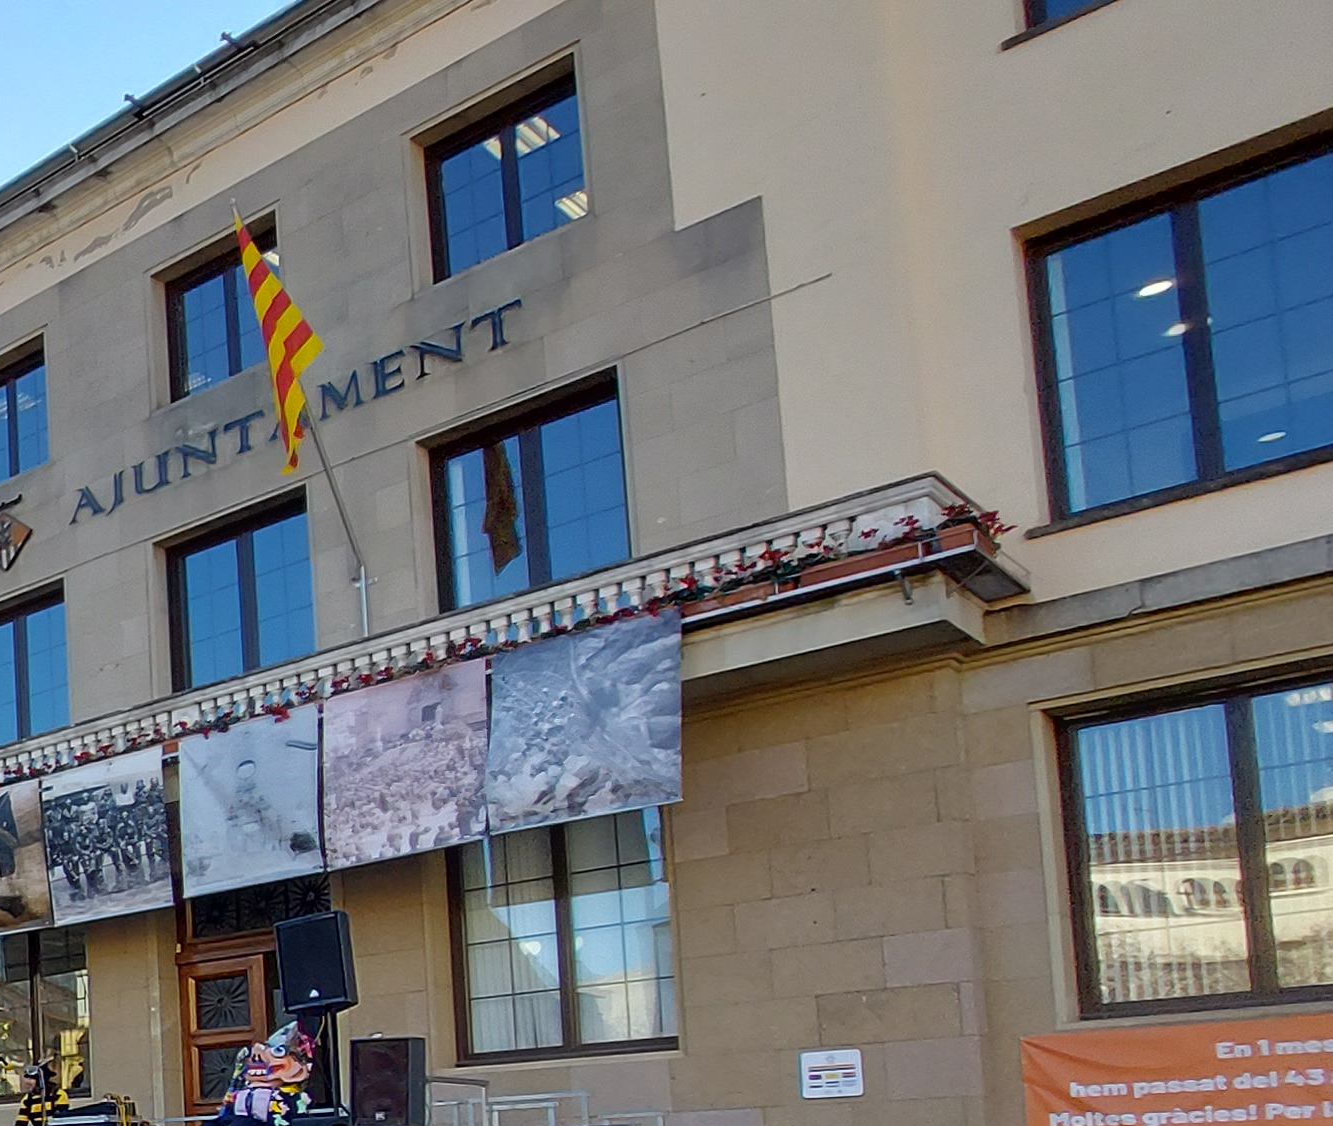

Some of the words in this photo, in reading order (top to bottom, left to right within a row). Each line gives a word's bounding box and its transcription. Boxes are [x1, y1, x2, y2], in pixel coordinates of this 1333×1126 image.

[69, 299, 523, 526] AJUNTMENT
[1216, 1041, 1252, 1059] En
[1256, 1039, 1270, 1056] 1
[1069, 1081, 1128, 1098] hem
[1133, 1075, 1228, 1099] passat
[1233, 1072, 1278, 1090] del
[1284, 1068, 1324, 1087] 43
[1265, 1103, 1315, 1120] Per
